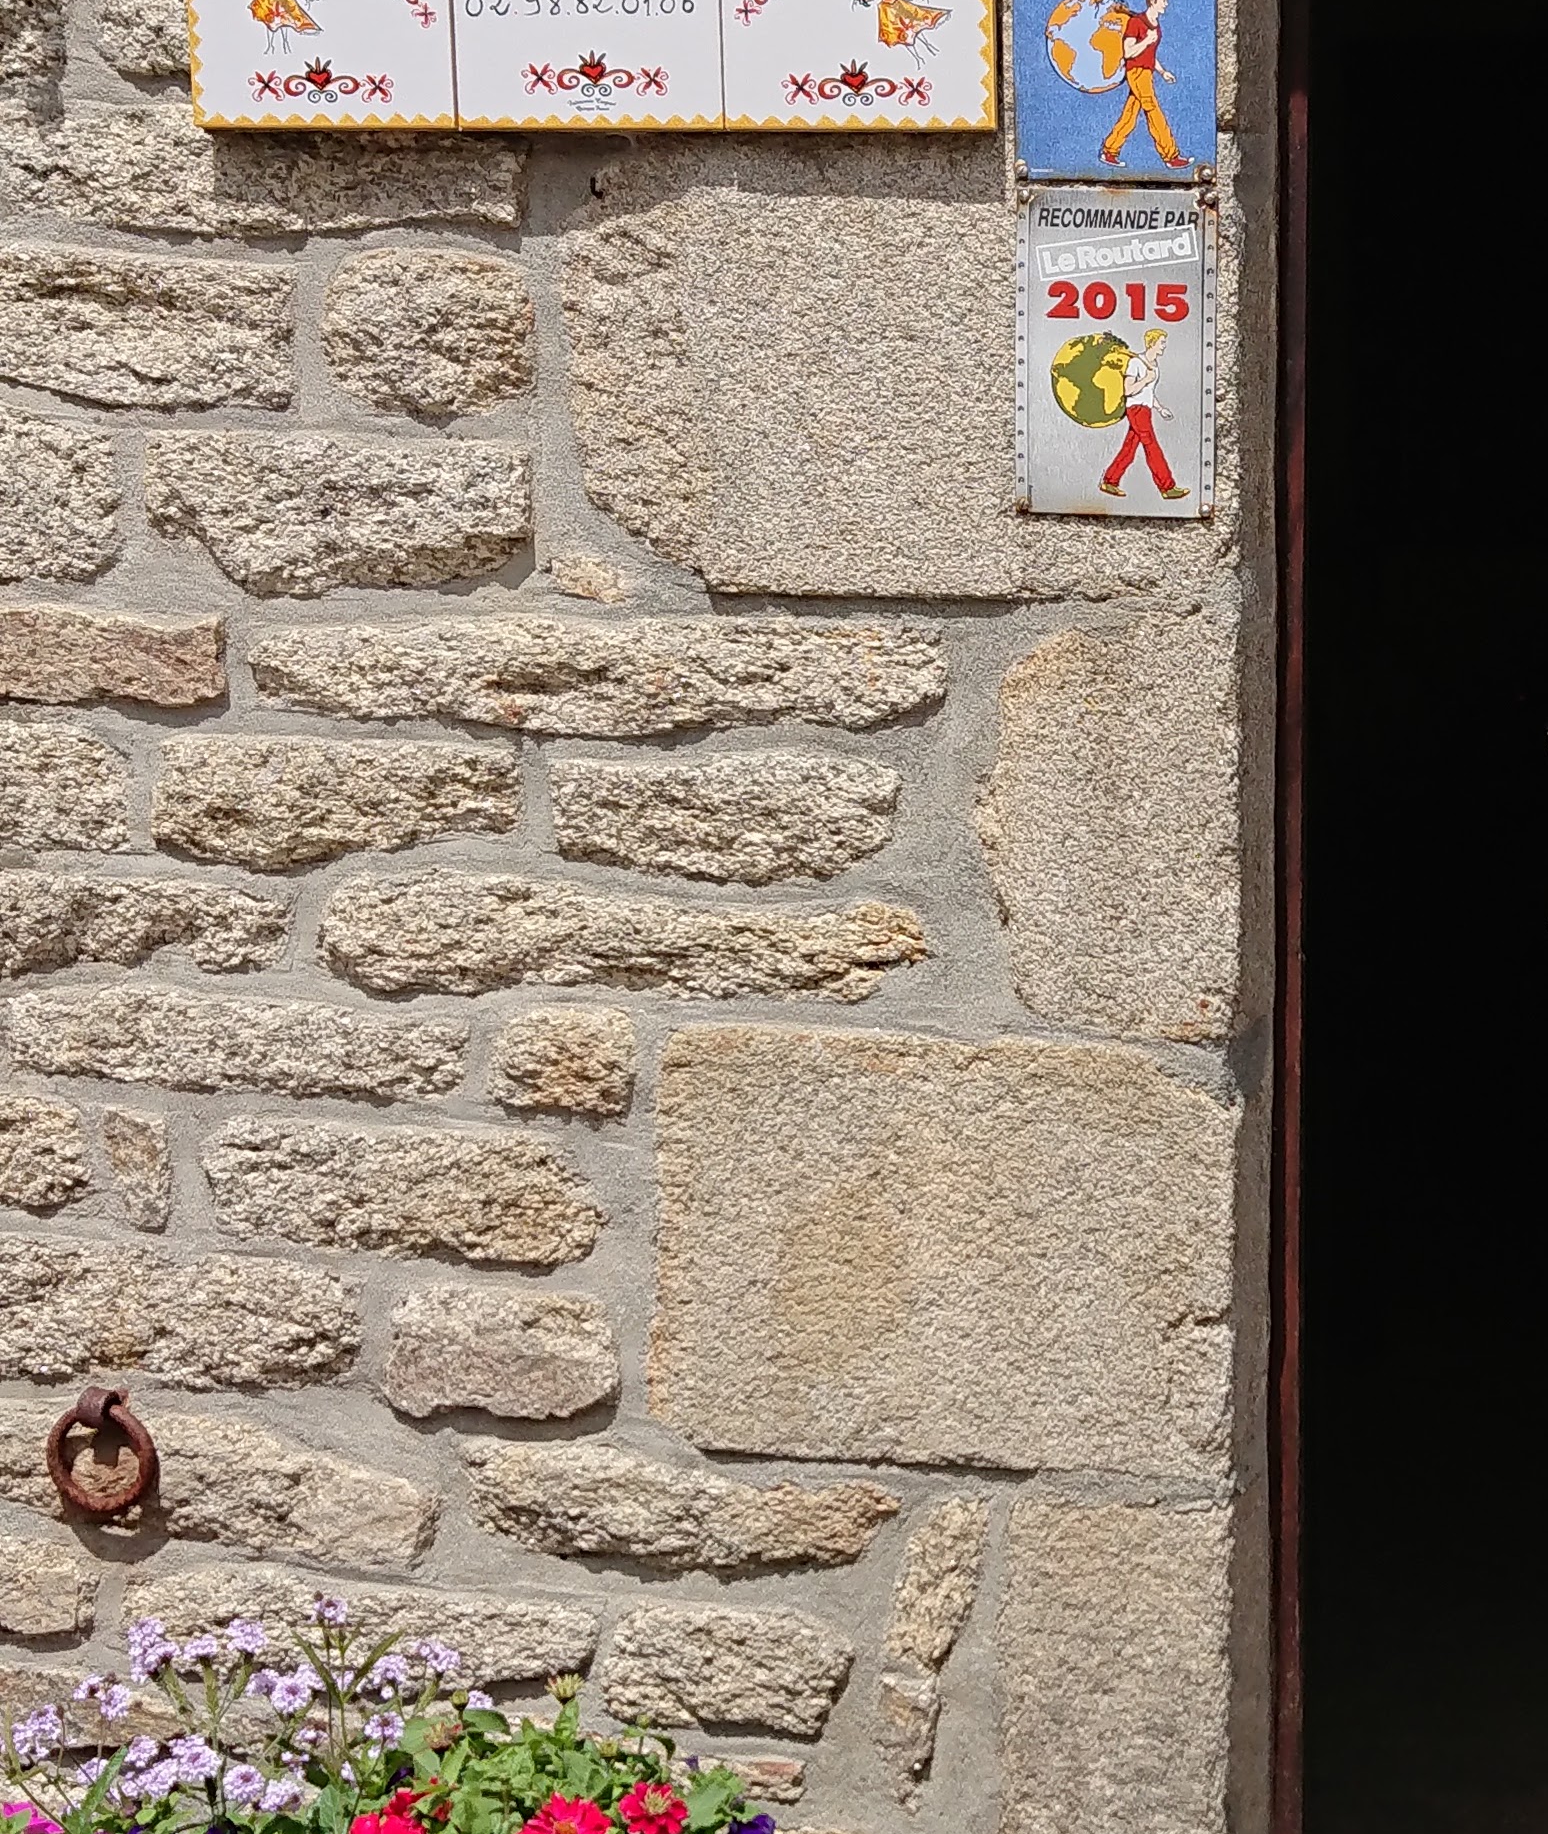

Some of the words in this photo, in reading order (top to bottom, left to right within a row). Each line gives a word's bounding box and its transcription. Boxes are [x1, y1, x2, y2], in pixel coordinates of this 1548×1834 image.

[1038, 207, 1160, 229] RECOMMANDÉ
[1164, 211, 1200, 231] PAR
[1046, 280, 1190, 322] 2015
